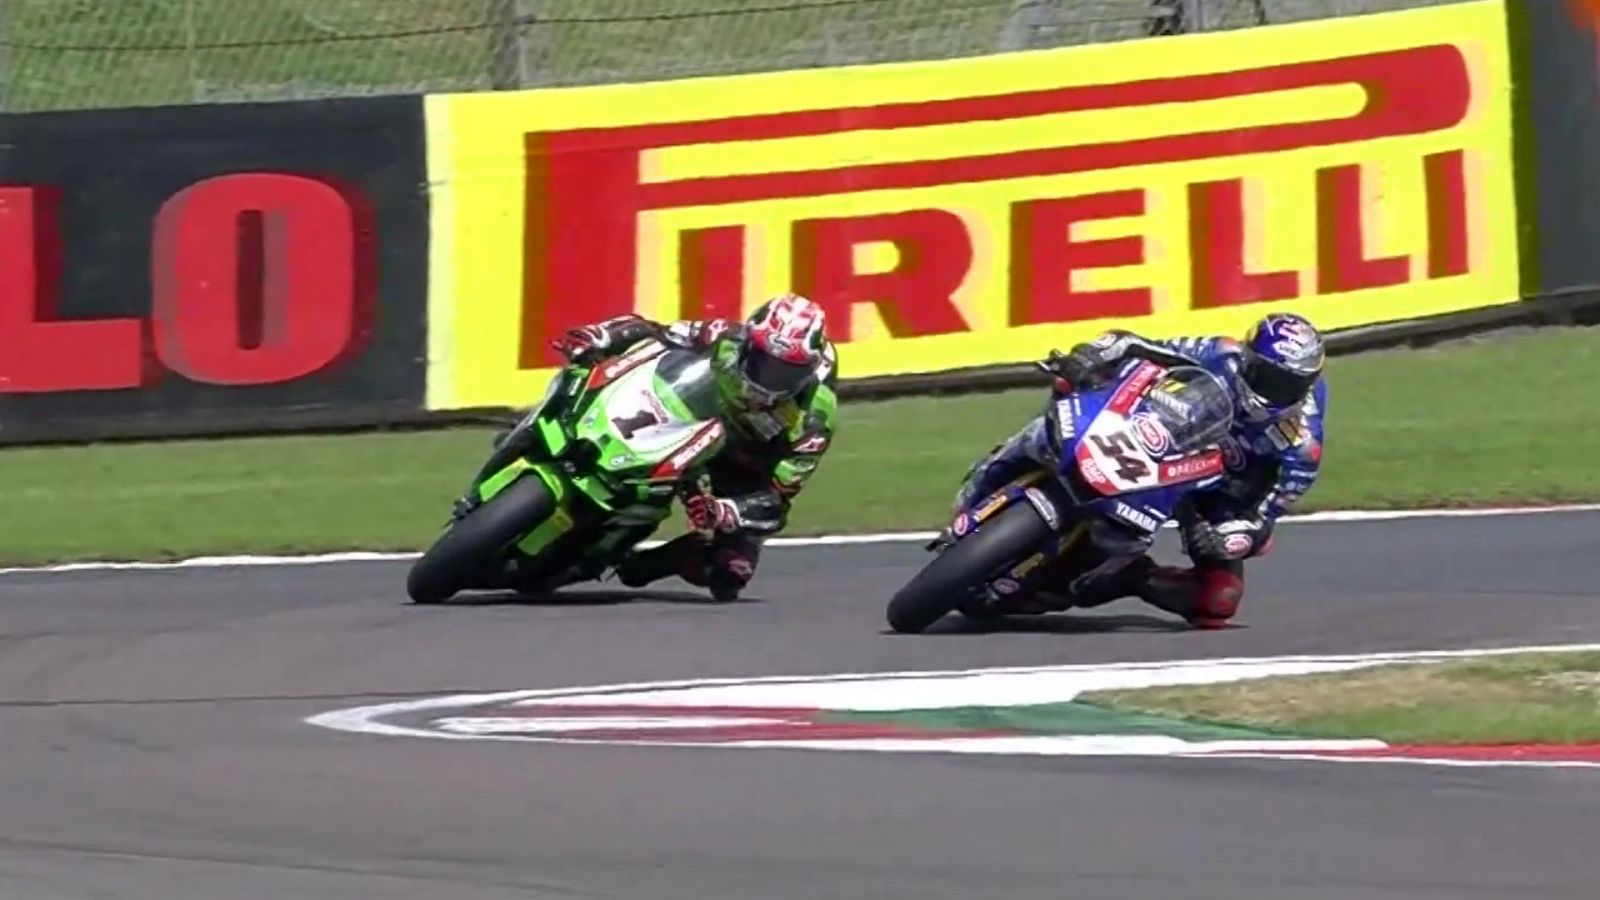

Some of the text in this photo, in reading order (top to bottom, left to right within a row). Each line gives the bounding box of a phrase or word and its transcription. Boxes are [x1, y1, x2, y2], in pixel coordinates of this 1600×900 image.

[519, 43, 1472, 370] PIRELLI
[610, 410, 659, 440] 1
[1089, 431, 1152, 483] 54
[1116, 501, 1157, 532] YAMAHA
